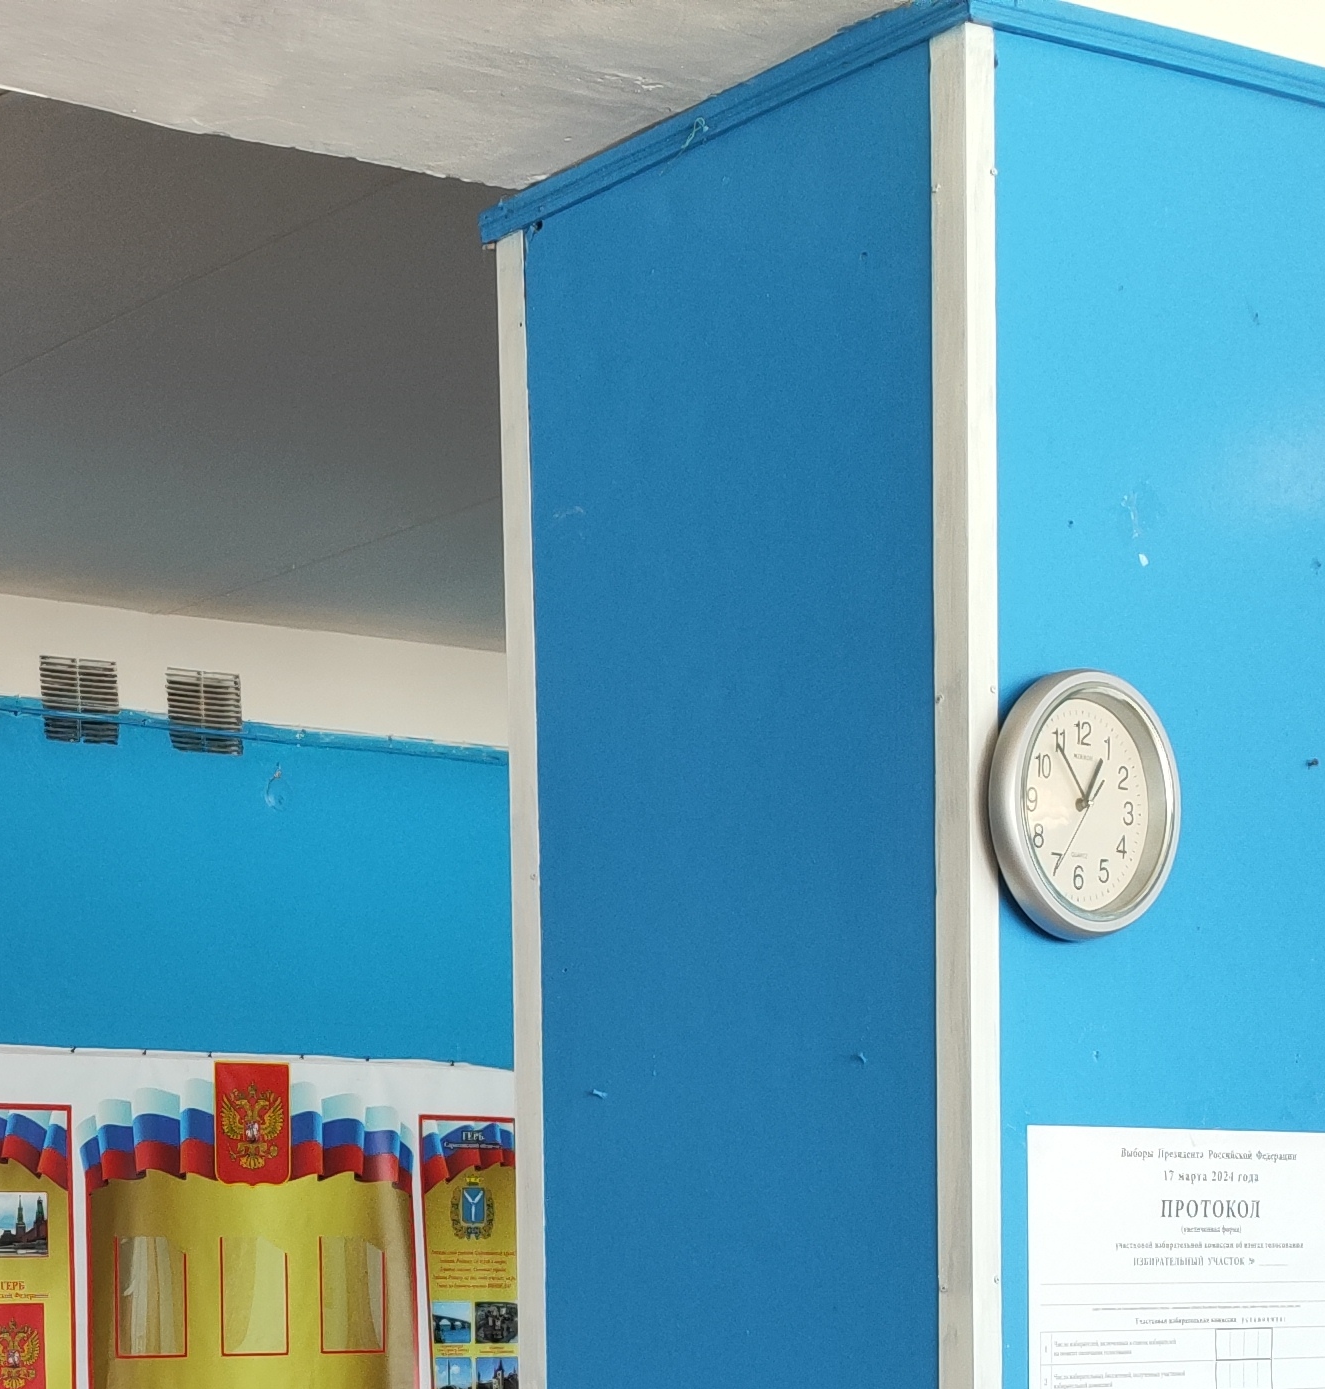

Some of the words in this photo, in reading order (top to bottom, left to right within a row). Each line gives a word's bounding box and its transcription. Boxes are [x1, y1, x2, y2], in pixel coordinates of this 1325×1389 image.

[1073, 721, 1092, 746] 12
[1103, 736, 1111, 760] 1
[1034, 753, 1052, 778] 10
[1117, 766, 1129, 790] 2
[1027, 787, 1038, 812] 9
[1123, 801, 1134, 826] 3
[1033, 823, 1044, 848] 8
[1116, 835, 1127, 859] 4
[1051, 852, 1063, 877] 7
[1098, 859, 1110, 883] 5
[1073, 865, 1084, 890] 6
[1121, 1148, 1154, 1161] Выборы
[1158, 1148, 1204, 1161] Президента
[1163, 1170, 1174, 1181] 17
[1178, 1172, 1208, 1184] марта
[1211, 1171, 1234, 1182] 2024
[1238, 1173, 1259, 1184] года
[1160, 1199, 1261, 1218] ПРОТОКОЛ
[1133, 1255, 1204, 1266] ИЗБИРАТЕЛЬНЫЙ
[1208, 1257, 1245, 1266] УЧАСТОК
[0, 1281, 25, 1291] ГЕРБ
